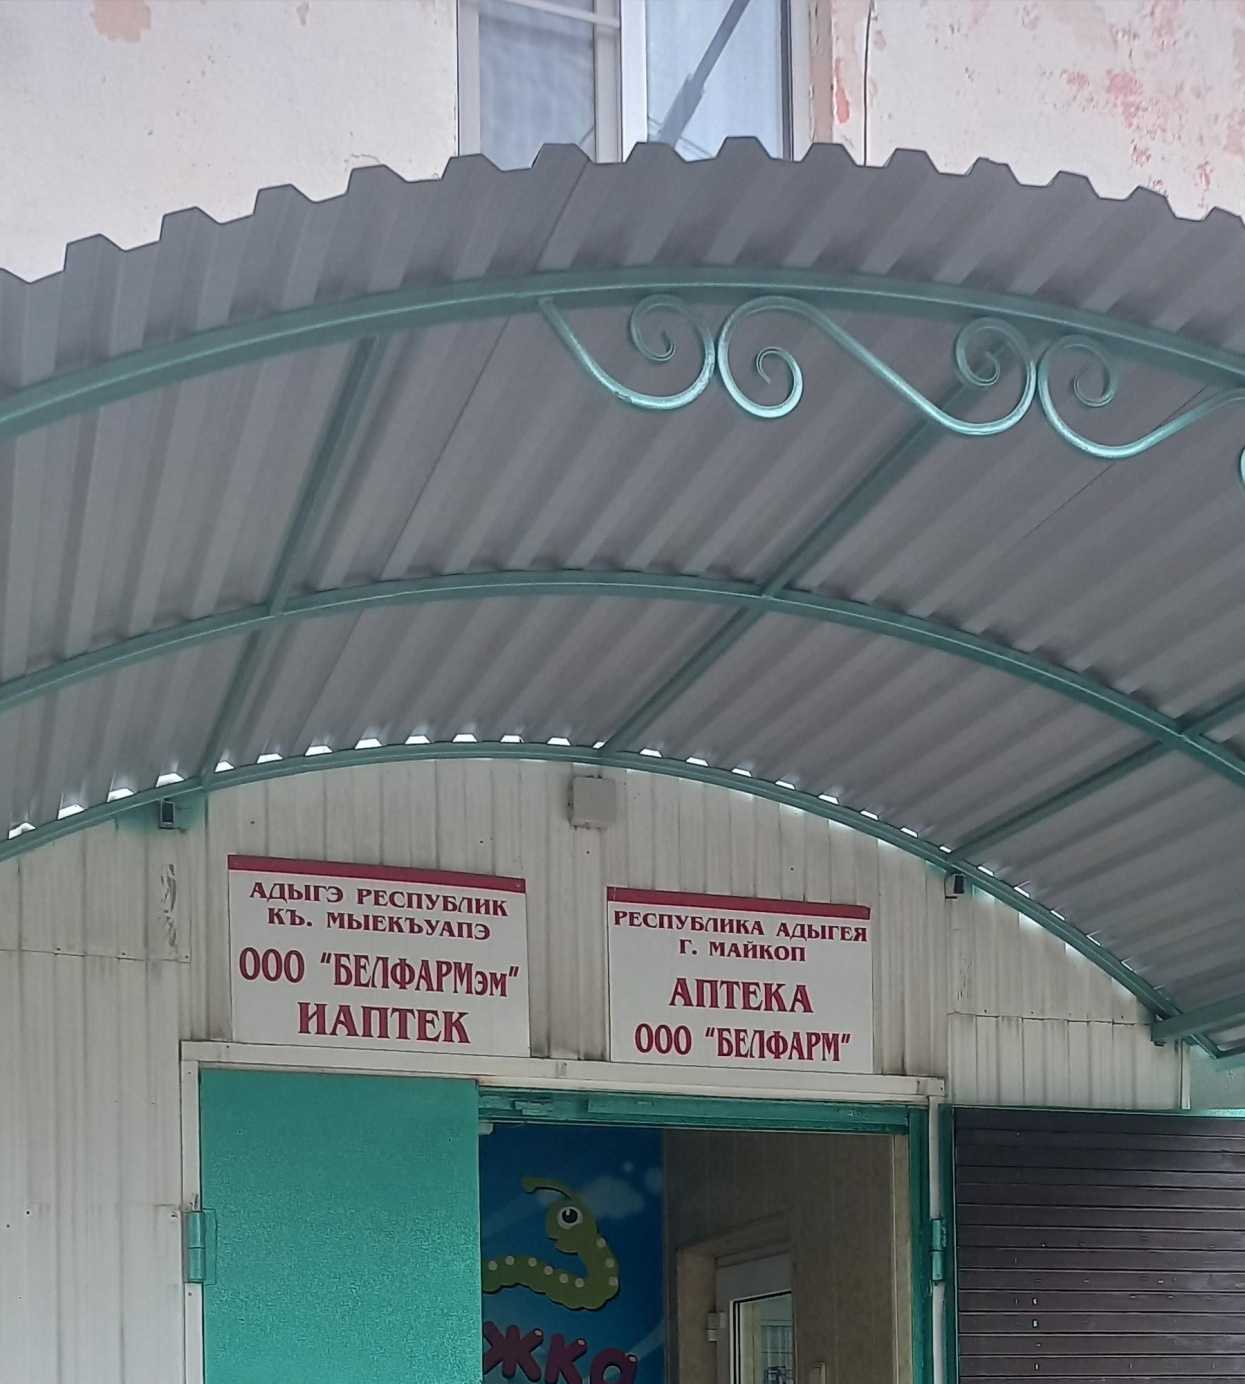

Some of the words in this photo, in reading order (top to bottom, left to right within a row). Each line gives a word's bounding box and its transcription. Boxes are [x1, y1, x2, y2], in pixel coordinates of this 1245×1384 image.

[249, 882, 343, 904] АДЫГЭ
[357, 889, 508, 917] РЕСПУБЛИК
[267, 908, 313, 927] КЪ.
[327, 912, 491, 940] МЫЕКЪУАПЭ
[614, 910, 765, 936] РЕСПУБЛИКА
[776, 922, 868, 942] АДЫГЕЯ
[239, 947, 305, 983] ООО
[679, 939, 698, 955] Г.
[710, 941, 806, 962] МАЙКОП
[669, 977, 814, 1013] АПТЕКА
[297, 1001, 471, 1044] ИАПТЕК
[635, 1023, 692, 1055] ООО
[705, 1027, 851, 1062] "БЕЛФАРМ"
